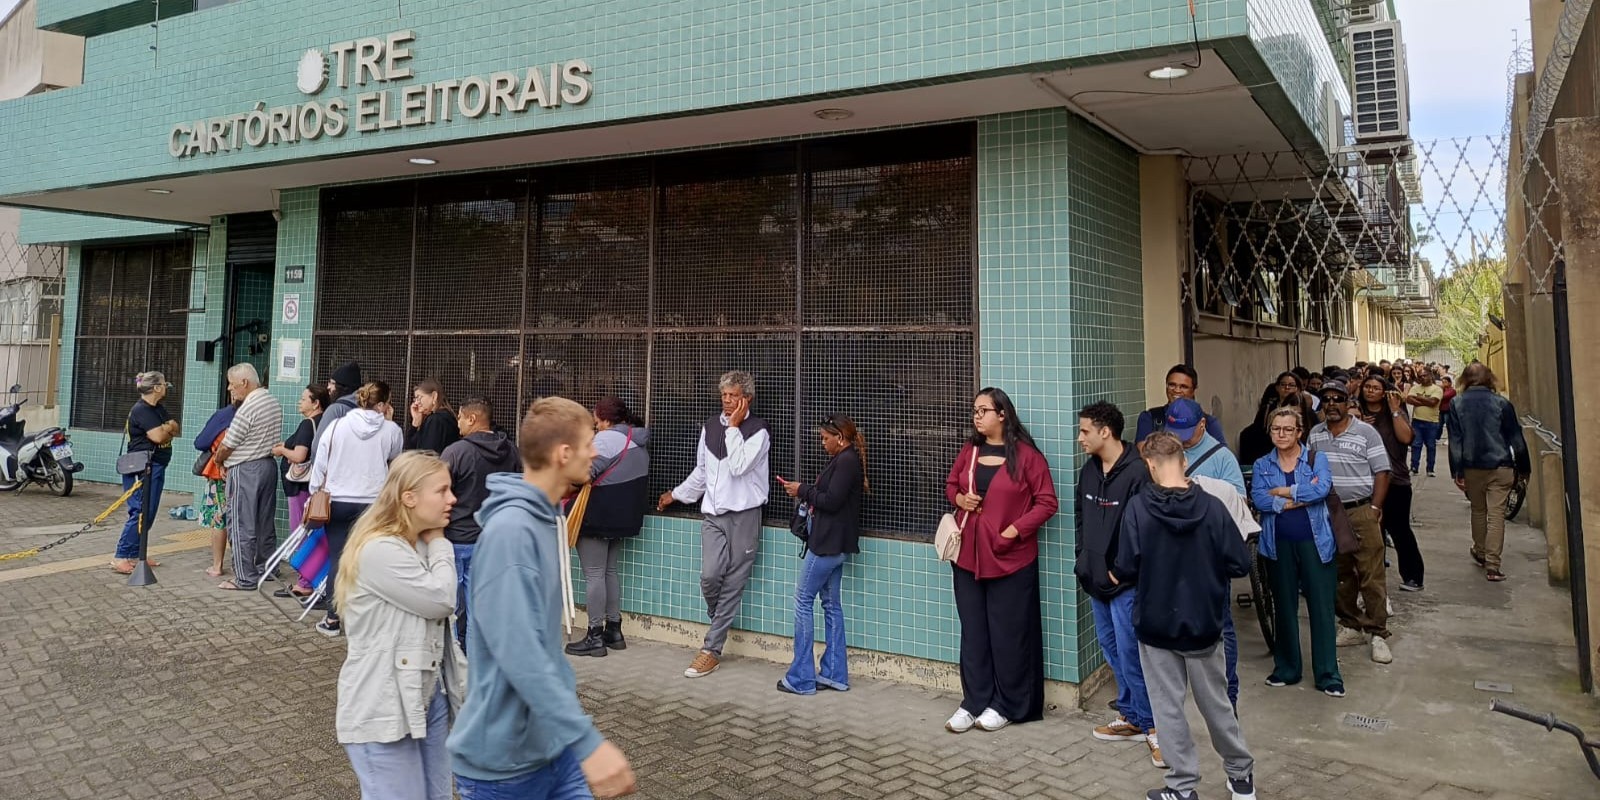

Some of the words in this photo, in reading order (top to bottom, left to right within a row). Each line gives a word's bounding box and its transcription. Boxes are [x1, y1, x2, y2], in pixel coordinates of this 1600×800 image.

[330, 29, 416, 88] TRE
[168, 97, 348, 158] CARTÓRIOS
[356, 58, 592, 132] ELEITORAIS
